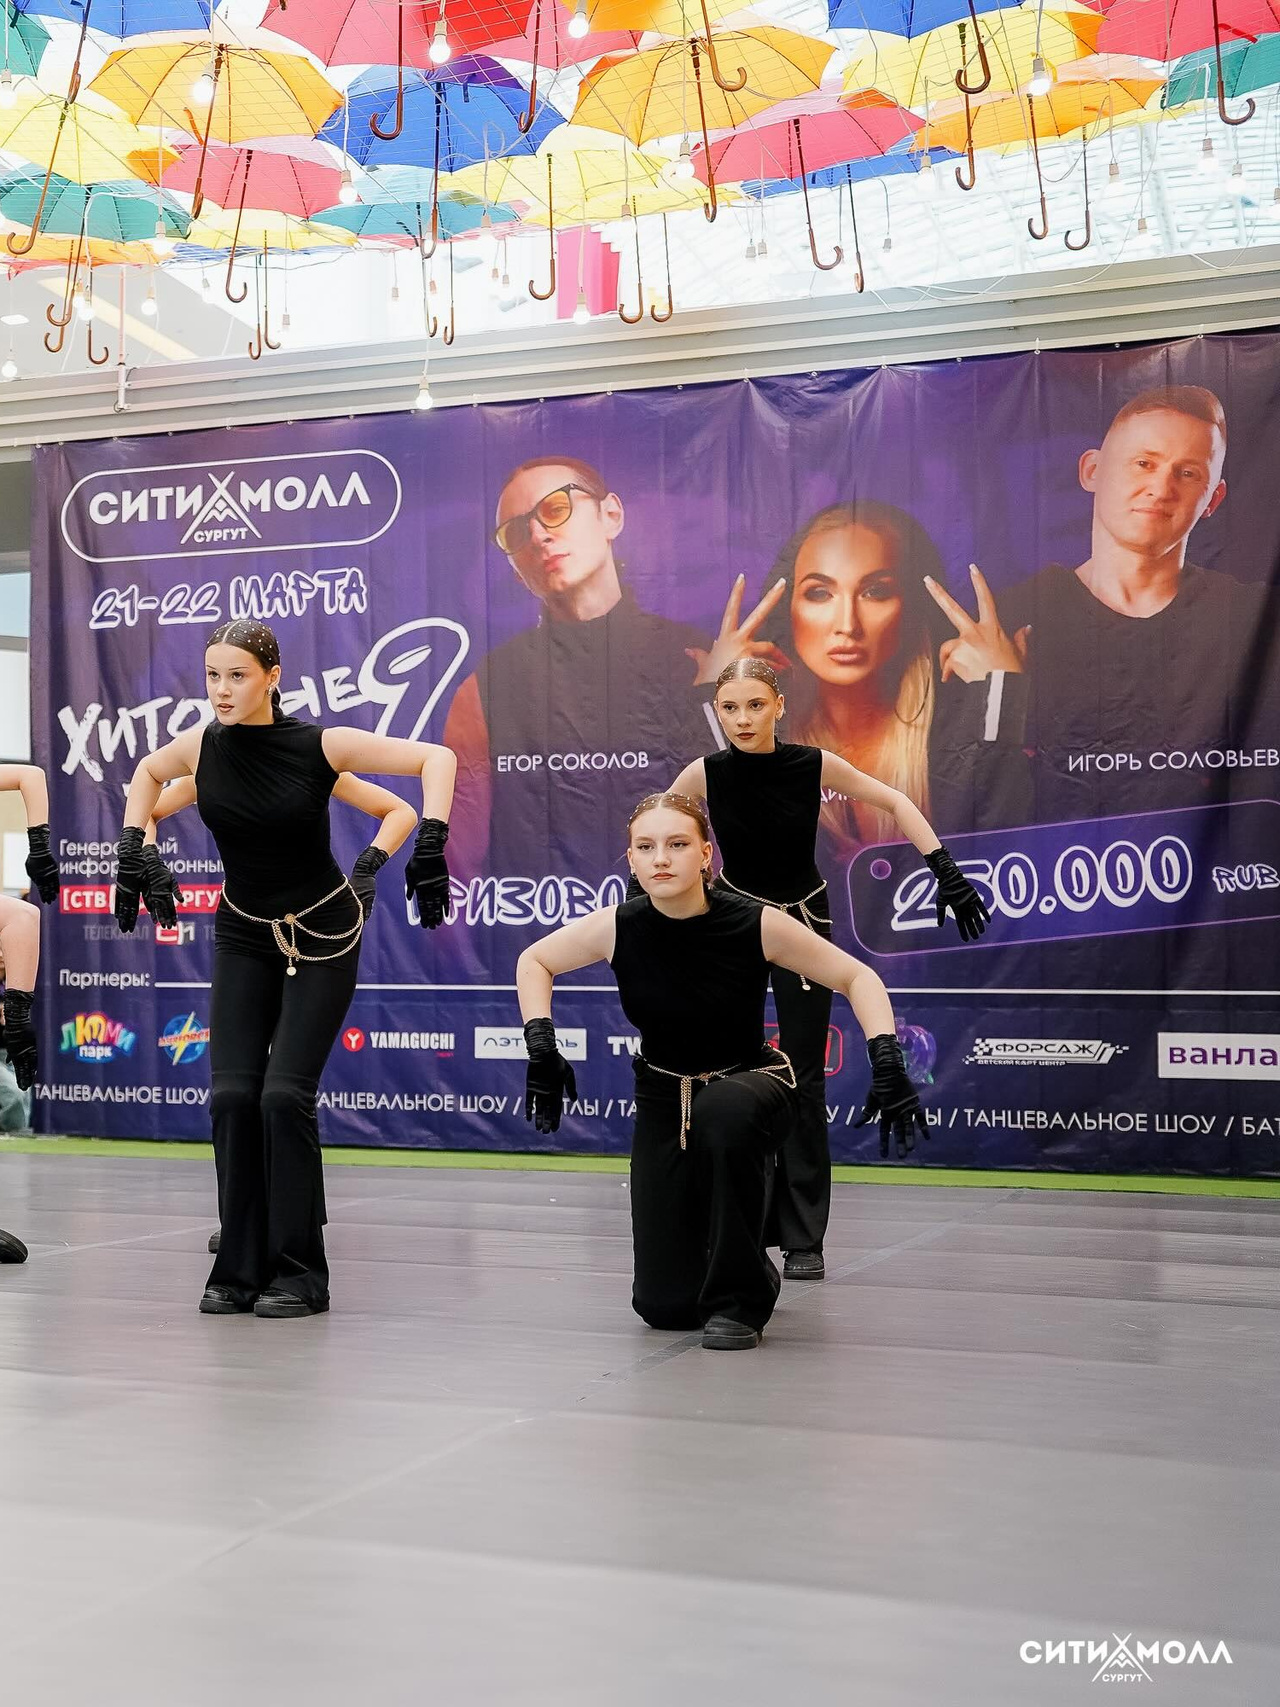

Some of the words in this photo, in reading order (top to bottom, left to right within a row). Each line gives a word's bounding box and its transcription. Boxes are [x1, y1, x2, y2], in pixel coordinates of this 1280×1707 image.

[193, 527, 248, 543] СУРГУТ
[89, 580, 222, 630] 21-22
[228, 566, 368, 622] МАРТА
[57, 666, 365, 783] ХИТОЫЕ
[497, 754, 542, 772] ЕГОР
[547, 751, 649, 770] СОКОЛОВ
[1068, 754, 1142, 773] ИГОРЬ
[1148, 749, 1280, 771] СОЛОВЬЕВ
[59, 836, 179, 858] Генераый
[1211, 863, 1280, 894] RUB
[404, 873, 627, 926] РИЗОВО
[59, 968, 151, 990] Партнеры:
[369, 1031, 456, 1050] YAMAGUCHI
[483, 1037, 579, 1048] ЛЭТЛЬ
[995, 1043, 1095, 1055] ФОРСАЖ
[79, 1046, 113, 1060] парк
[1169, 1046, 1278, 1066] ванла
[34, 1083, 162, 1104] ТАНЦЕВАЛЬНОЕ
[165, 1086, 210, 1105] ШОУ
[316, 1091, 455, 1112] АНЦЕВАЛЬНОЕ
[460, 1094, 508, 1113] ШОУ
[531, 1097, 599, 1116] ТЛЫ
[963, 1108, 1148, 1134] ТАНЦЕВАЛЬНОЕ
[1155, 1114, 1216, 1134] ШОУ
